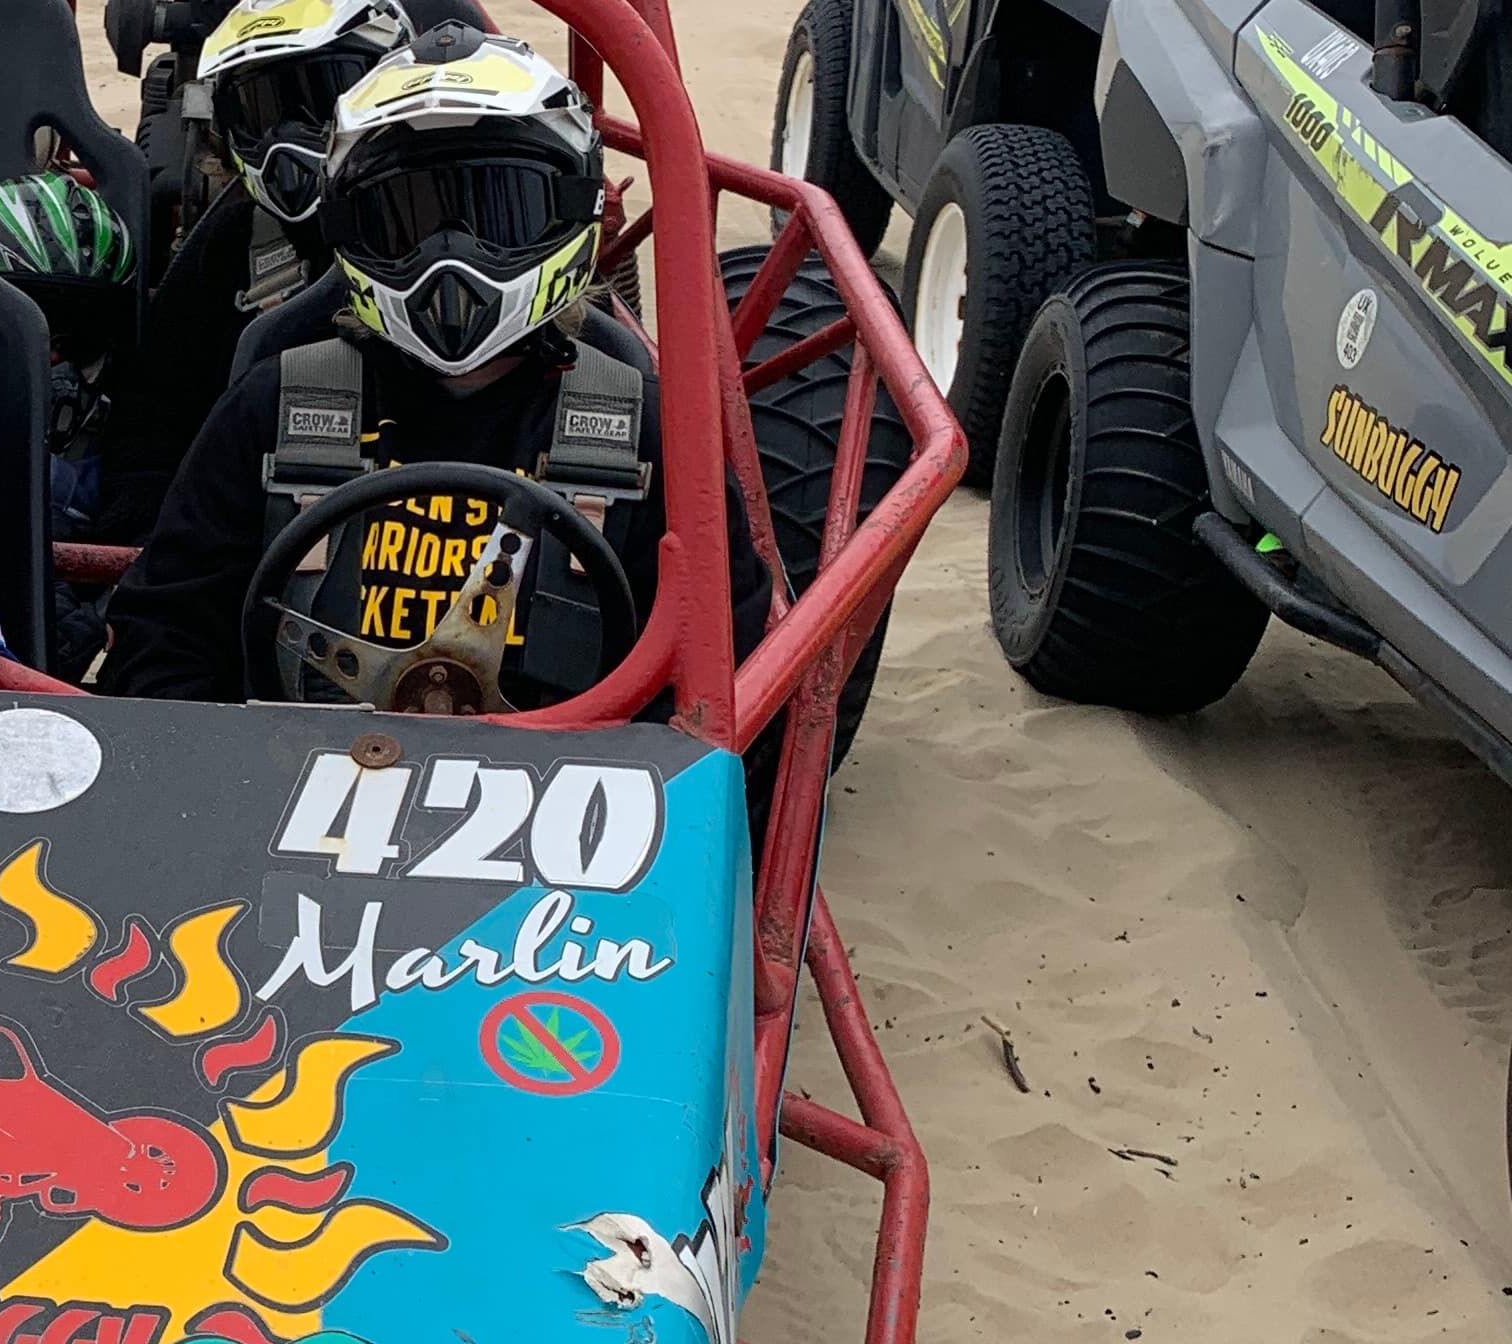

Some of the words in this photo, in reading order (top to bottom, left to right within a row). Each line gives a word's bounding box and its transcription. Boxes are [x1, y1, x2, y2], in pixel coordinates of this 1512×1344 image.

[1285, 92, 1336, 153] 1000
[292, 412, 336, 426] CROW
[569, 414, 613, 430] CROW
[1320, 385, 1462, 534] SUNBUGGY
[277, 752, 659, 889] 420
[254, 889, 674, 1012] Marlin
